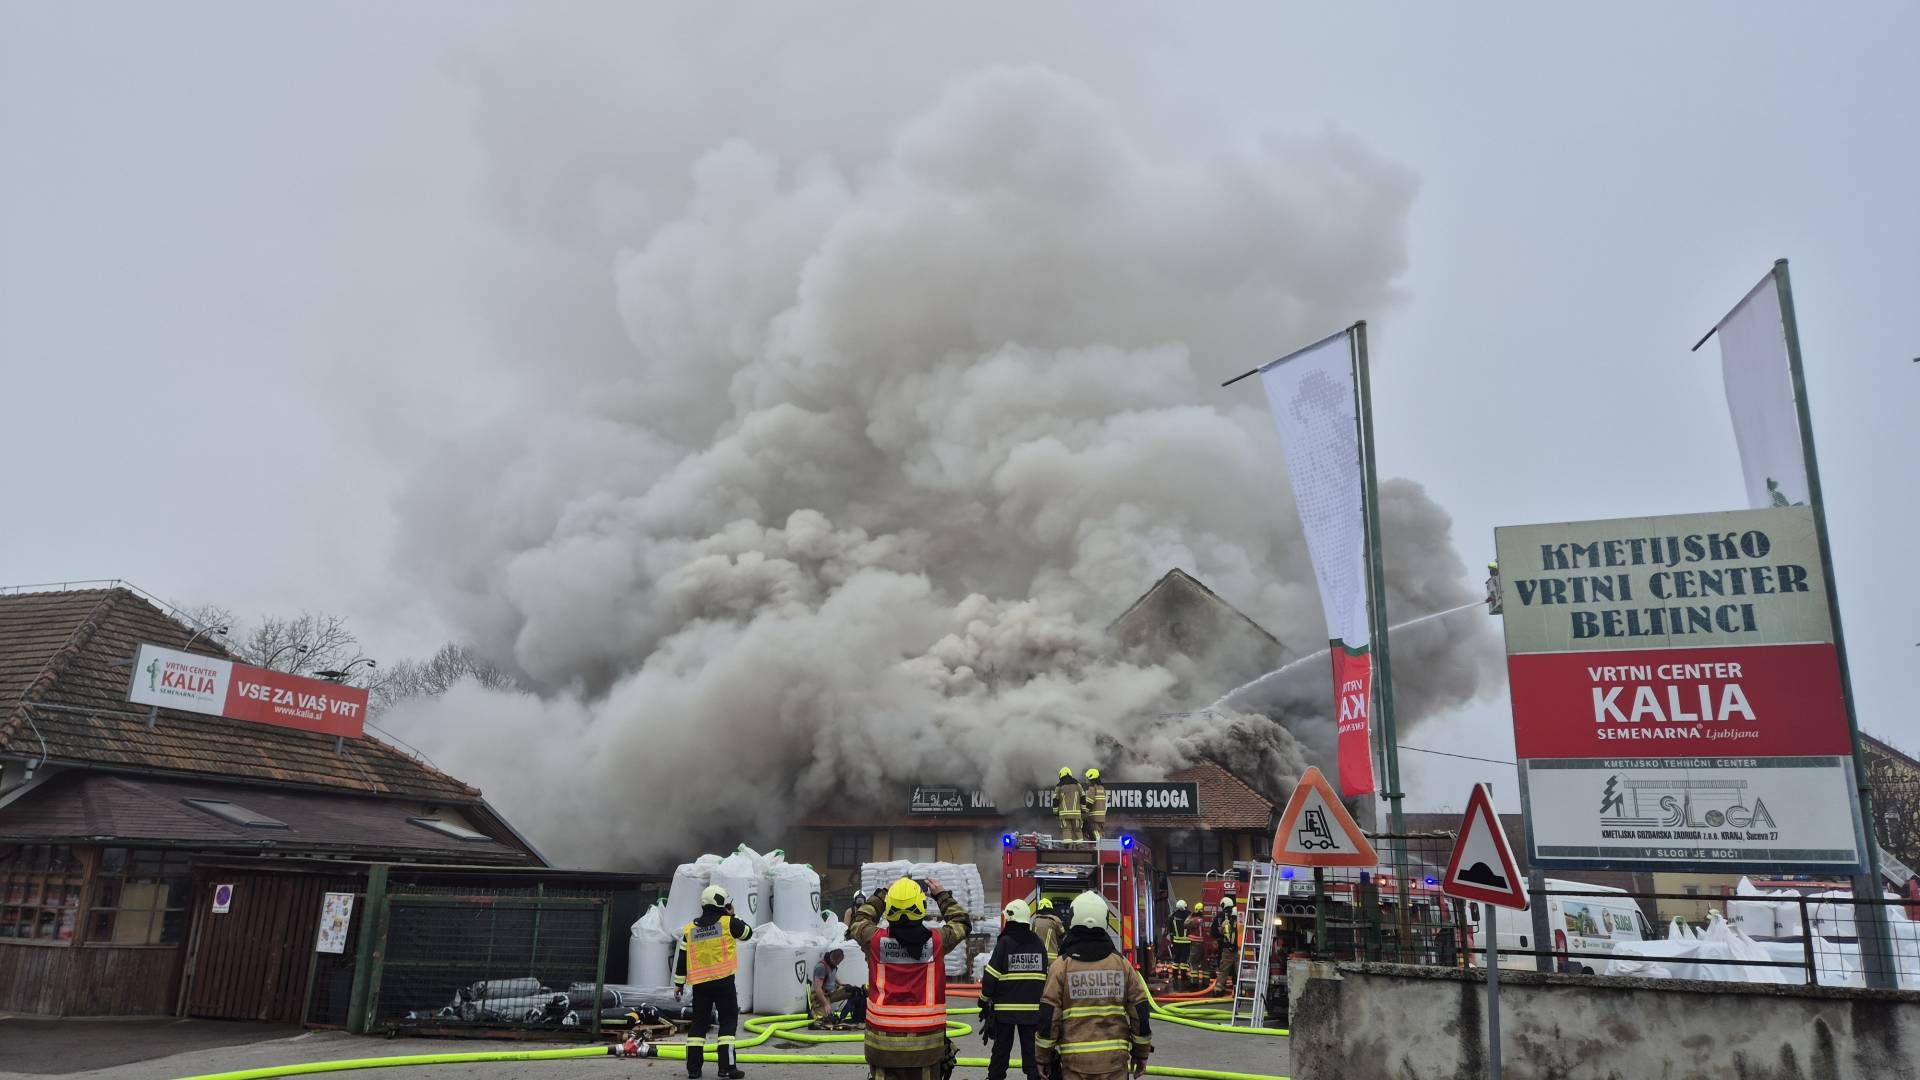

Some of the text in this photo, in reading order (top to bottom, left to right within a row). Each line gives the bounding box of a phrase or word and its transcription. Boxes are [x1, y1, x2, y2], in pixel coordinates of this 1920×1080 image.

[1540, 530, 1771, 571] KMETIJSKO
[1513, 564, 1810, 607] VRTNI CENTER
[1570, 603, 1758, 639] BELTINCI
[166, 662, 217, 677] VRTNI CENTER
[1587, 662, 1743, 682] VRTNI CENTER
[161, 670, 214, 695] KALIA
[236, 681, 360, 718] VSE ZA VAŠ VRT
[1591, 683, 1757, 723] KALIA
[274, 704, 322, 721] www.kalia.si
[1597, 727, 1759, 741] SEMENARNA Ljubljana
[1604, 758, 1758, 768] KMETIJSKO TEHNIČNI CENTER
[1104, 789, 1190, 809] ENTER SLOGA
[1601, 830, 1636, 840] KMETIJSKA
[1673, 831, 1702, 840] ZADRUGA
[1769, 831, 1779, 841] 27
[1645, 848, 1739, 859] V SLOGI JE MOČI
[1612, 913, 1634, 932] SLOGA
[1011, 954, 1039, 964] GASILEC
[1071, 972, 1121, 987] GASILEC
